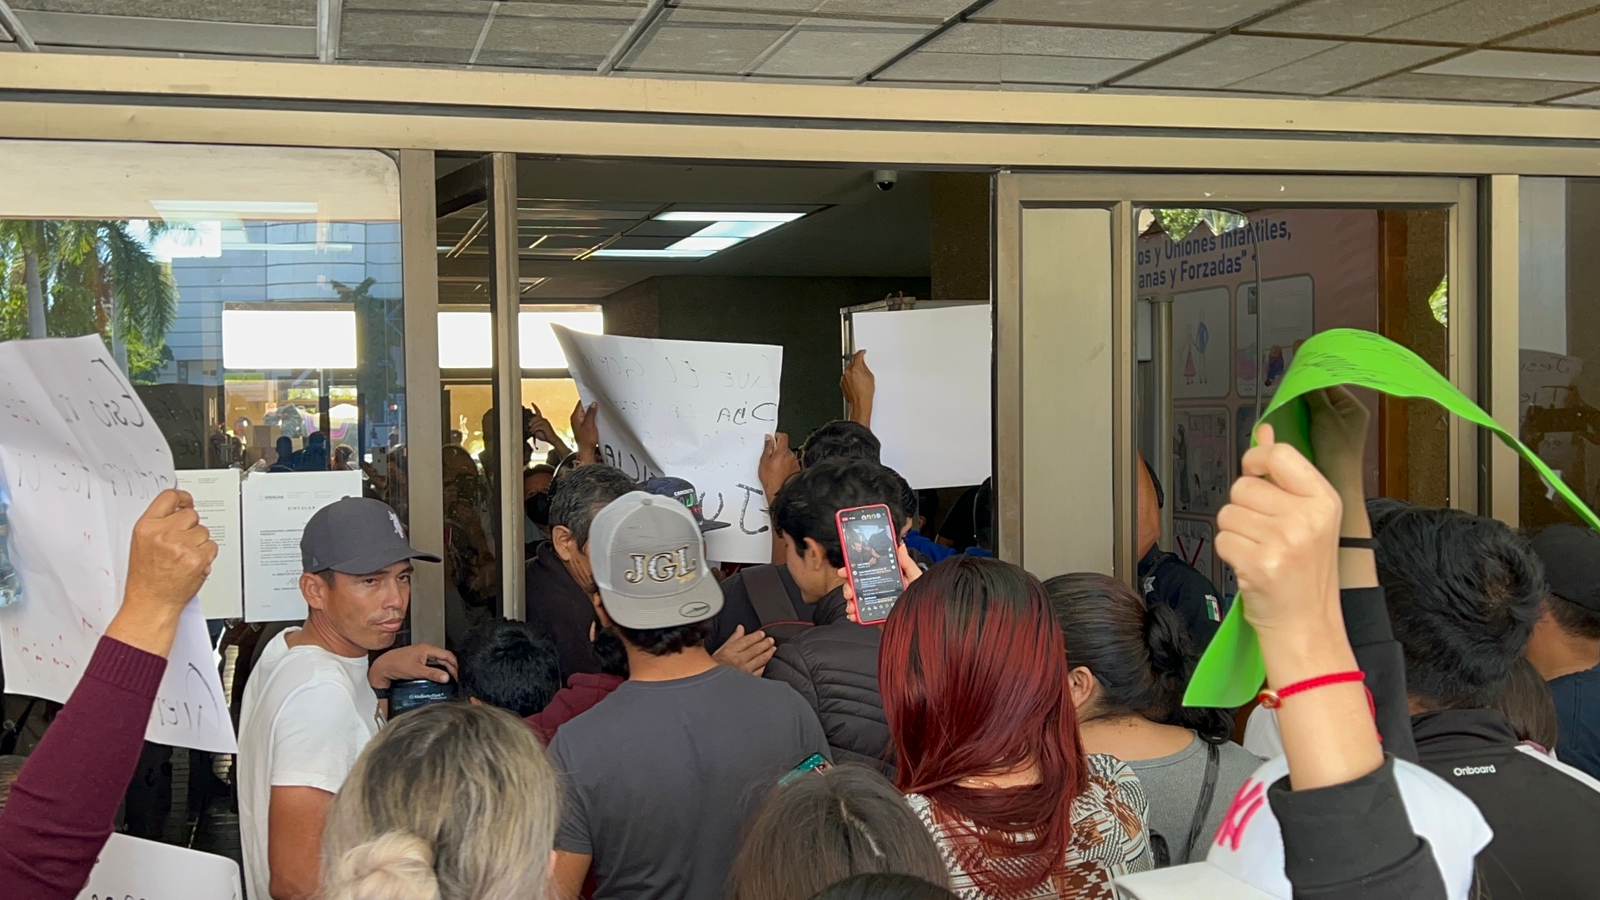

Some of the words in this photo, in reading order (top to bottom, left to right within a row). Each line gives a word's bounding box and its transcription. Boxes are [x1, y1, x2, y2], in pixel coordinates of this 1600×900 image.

[1137, 247, 1152, 266] os
[1154, 247, 1162, 268] y
[1165, 234, 1217, 261] Uniones
[1221, 217, 1292, 249] Infantiles,
[1138, 269, 1167, 290] anas
[1169, 267, 1177, 290] y
[624, 544, 697, 583] JGL
[1452, 763, 1497, 778] Onboard
